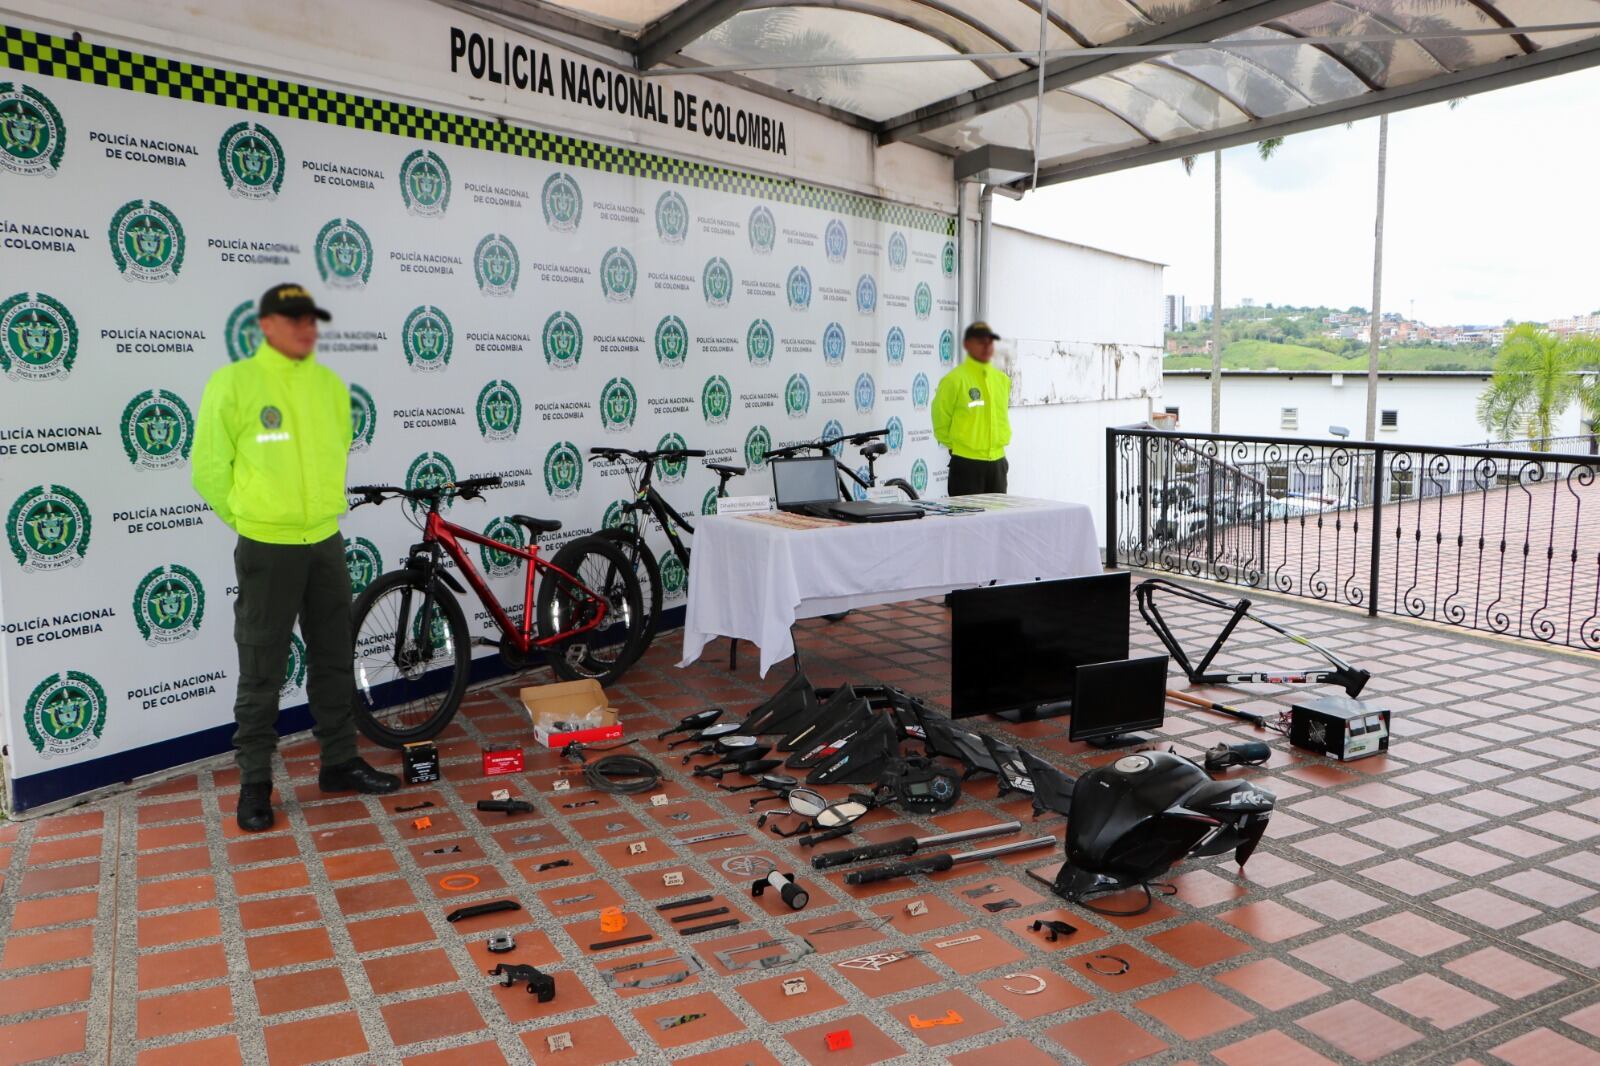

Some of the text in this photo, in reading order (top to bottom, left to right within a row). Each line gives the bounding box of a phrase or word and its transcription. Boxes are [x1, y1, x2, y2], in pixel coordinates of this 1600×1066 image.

[450, 27, 786, 156] POLICIA NACIONAL DE COLOMBIA
[90, 132, 198, 155] POLICÍA NACIONAL
[106, 148, 186, 166] DE COLOMBIA
[303, 161, 384, 179] POLICÍA NACIONAL
[314, 175, 374, 189] DE COLOMBIA
[495, 187, 529, 198] NACIONAL
[474, 195, 521, 208] DE COLOMBIA
[22, 225, 89, 239] NACIONAL
[4, 238, 75, 252] COLOMBIA
[208, 239, 248, 249] POLICÍA
[222, 253, 235, 262] DE
[390, 252, 462, 264] POLICÍA NACIONAL
[401, 264, 454, 274] DE COLOMBIA
[560, 265, 591, 274] NACIONAL
[552, 274, 584, 283] COLOMBIA
[101, 328, 206, 339] POLICÍA NACIONAL
[467, 332, 494, 341] POLICÍA
[117, 344, 193, 352] DE COLOMBIA
[394, 407, 464, 417] POLICÍA NACIONAL
[404, 419, 456, 428] DE COLOMBIA
[0, 426, 102, 440] LICÍA NACIONAL
[0, 442, 88, 454] DE COLOMBIA
[499, 469, 532, 477] NACIONAL
[113, 508, 157, 522] POLICÍA
[128, 517, 203, 533] DE COLOMBIA
[563, 528, 593, 537] NACIONAL
[53, 608, 115, 625] NACIONAL
[484, 620, 492, 628] DE
[16, 624, 102, 646] DE COLOMBIA
[353, 644, 390, 659] OOMBIA
[128, 670, 226, 700] POLICÍA NACIONAL
[143, 686, 215, 710] DE COLOMBIA
